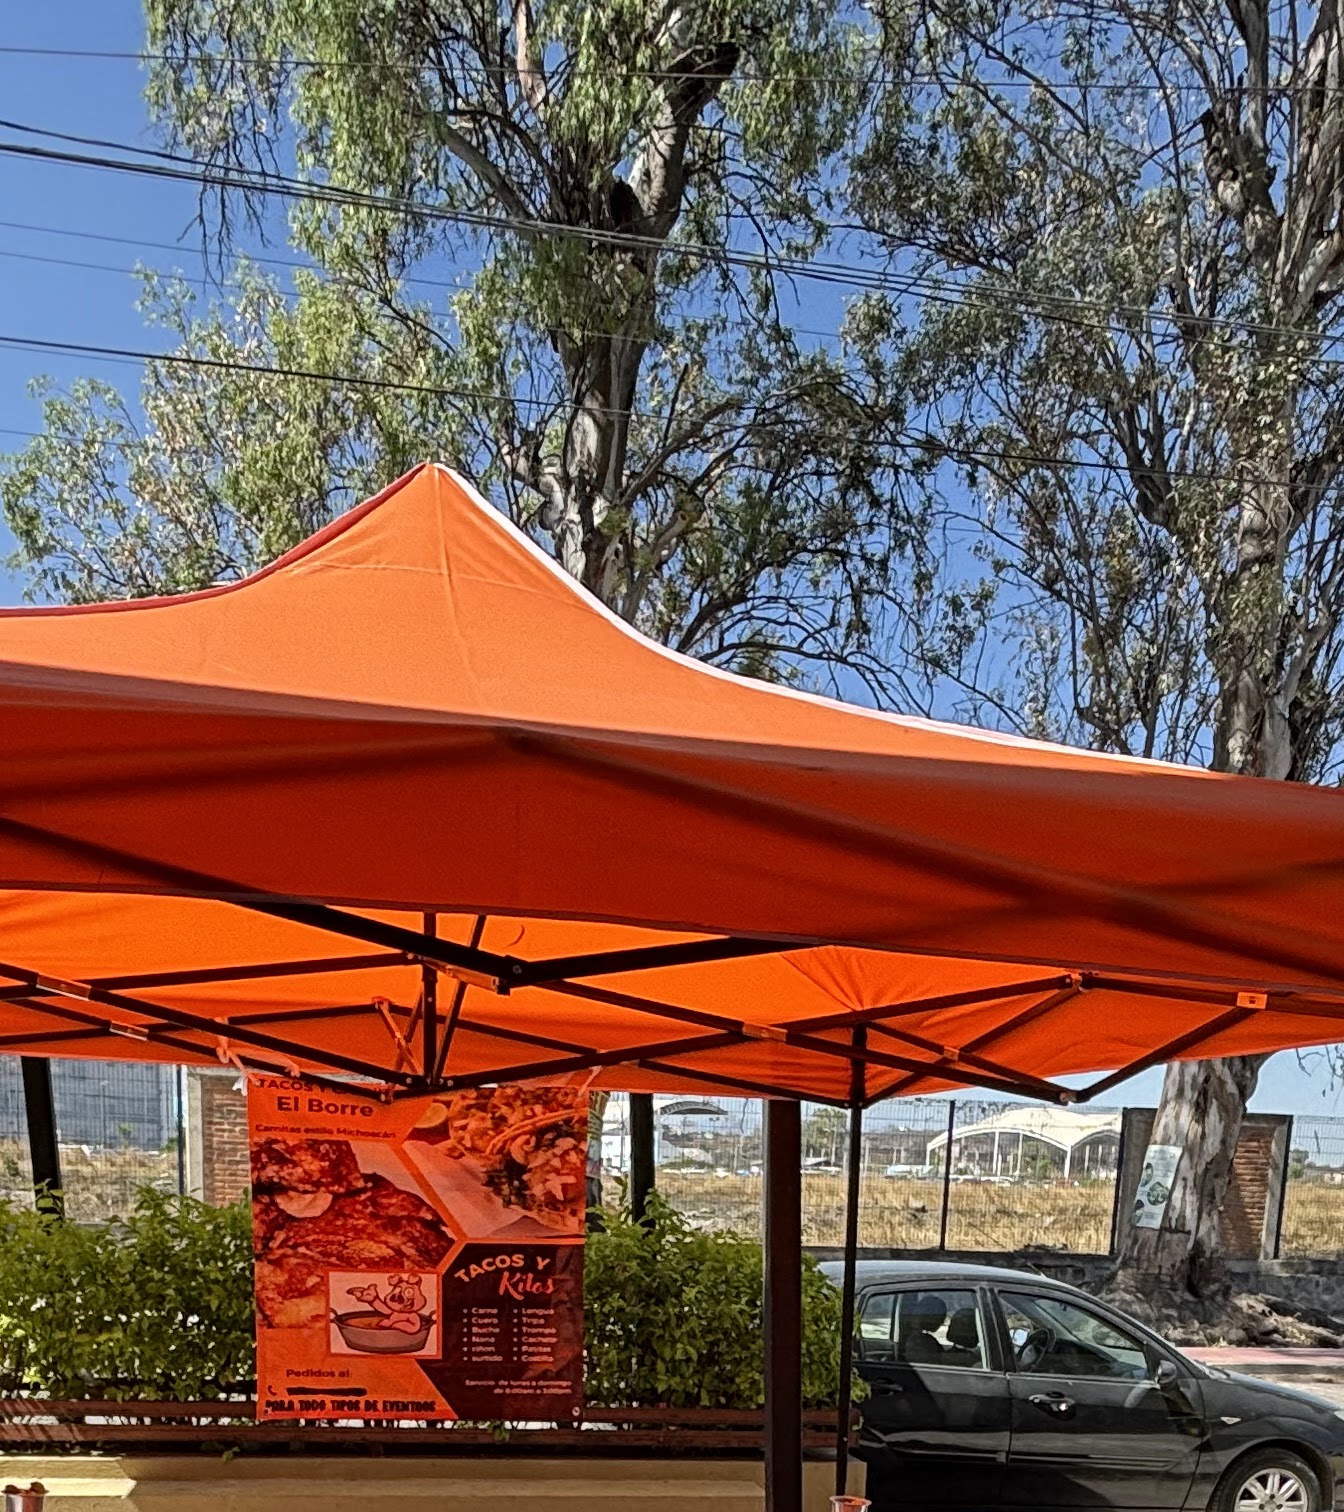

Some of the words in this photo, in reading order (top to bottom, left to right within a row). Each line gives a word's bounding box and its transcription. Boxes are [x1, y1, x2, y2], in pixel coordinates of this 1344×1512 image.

[257, 1078, 314, 1092] TACOS
[277, 1096, 299, 1111] El
[308, 1098, 374, 1117] Borre
[256, 1124, 301, 1134] Carnitas
[303, 1126, 334, 1135] estilo
[454, 1254, 524, 1282] TACOS
[536, 1256, 551, 1270] Y
[499, 1271, 555, 1300] Kilos
[286, 1369, 335, 1377] Pedidos
[364, 1400, 378, 1412] DE
